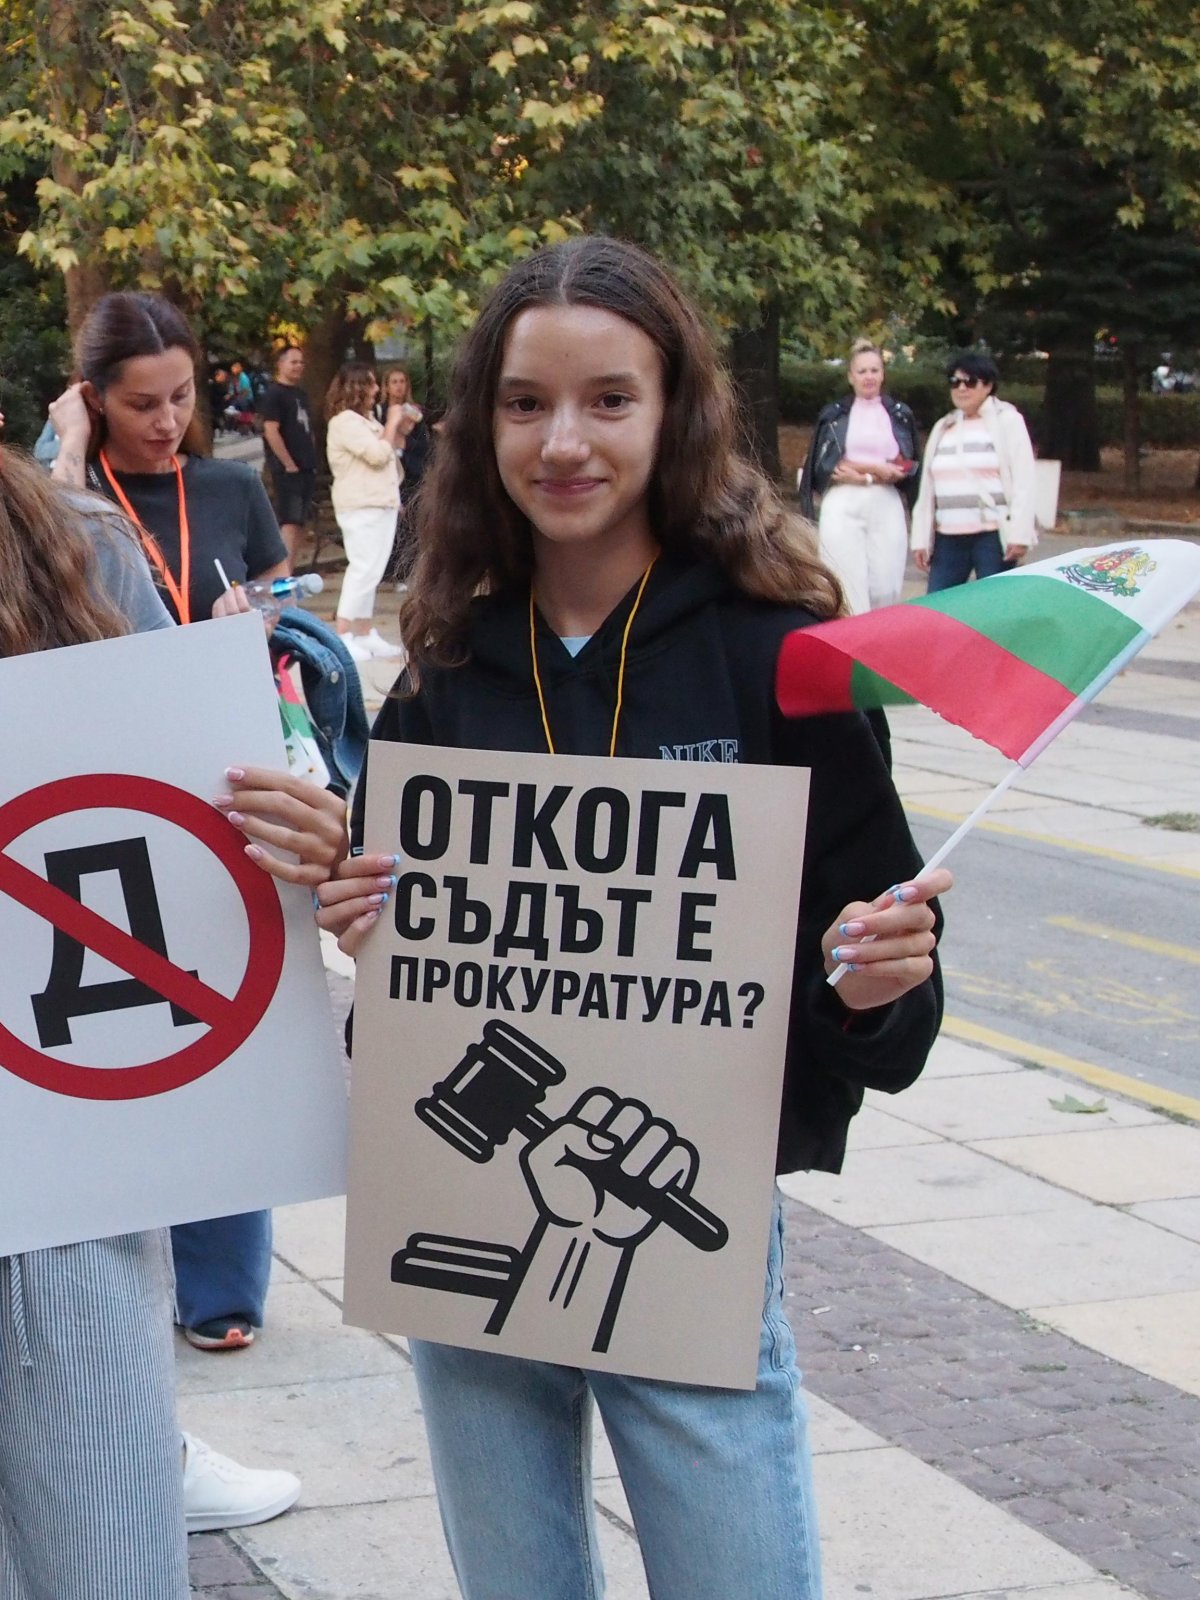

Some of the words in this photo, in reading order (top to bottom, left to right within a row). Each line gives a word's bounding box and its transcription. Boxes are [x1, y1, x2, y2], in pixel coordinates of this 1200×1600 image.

[399, 774, 737, 881] ОТКОГА
[30, 836, 204, 1049] Д
[394, 871, 653, 962] СЪДЪТ
[676, 891, 718, 963] Е
[389, 954, 766, 1030] ПРОКУРАТУРА?
